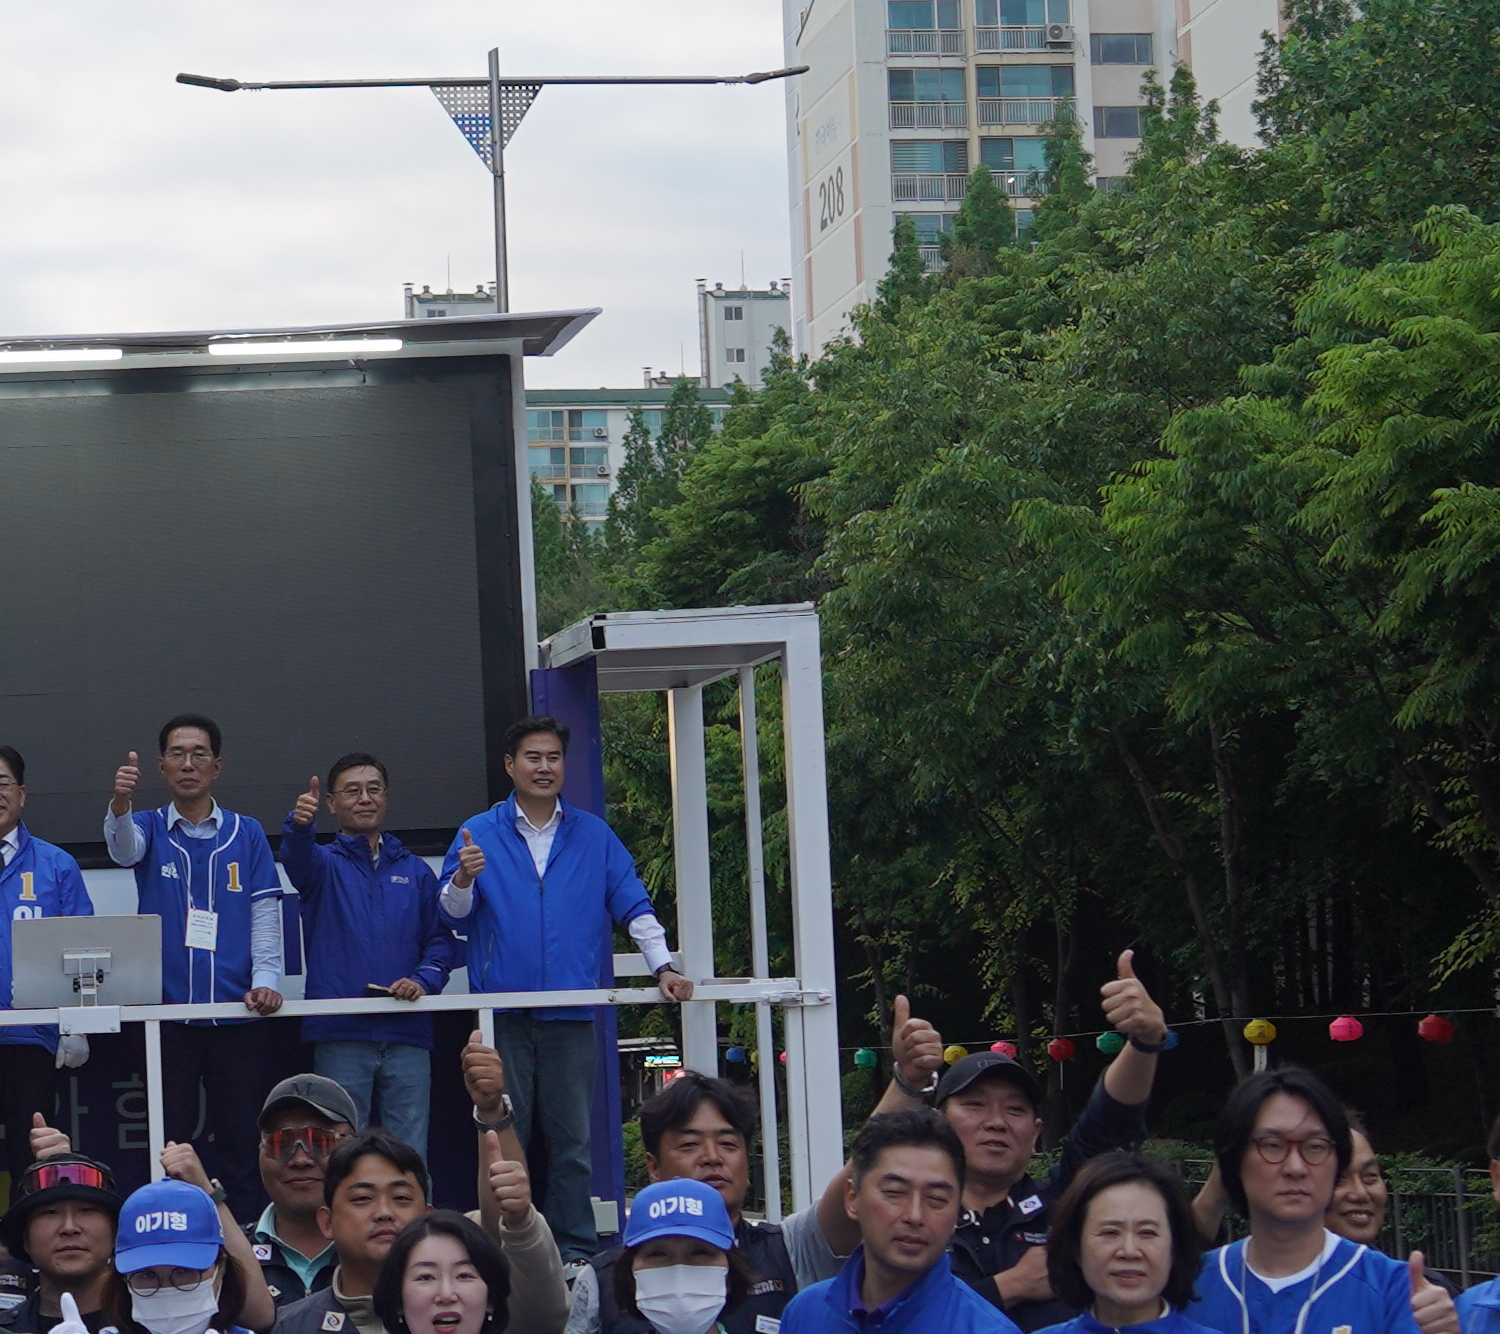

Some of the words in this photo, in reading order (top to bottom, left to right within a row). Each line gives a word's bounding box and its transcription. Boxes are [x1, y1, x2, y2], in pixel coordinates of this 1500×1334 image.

[819, 165, 844, 232] 208
[20, 871, 37, 903] 1
[226, 861, 243, 893] 1
[134, 1210, 188, 1234] 이기형
[648, 1193, 705, 1219] 이기형
